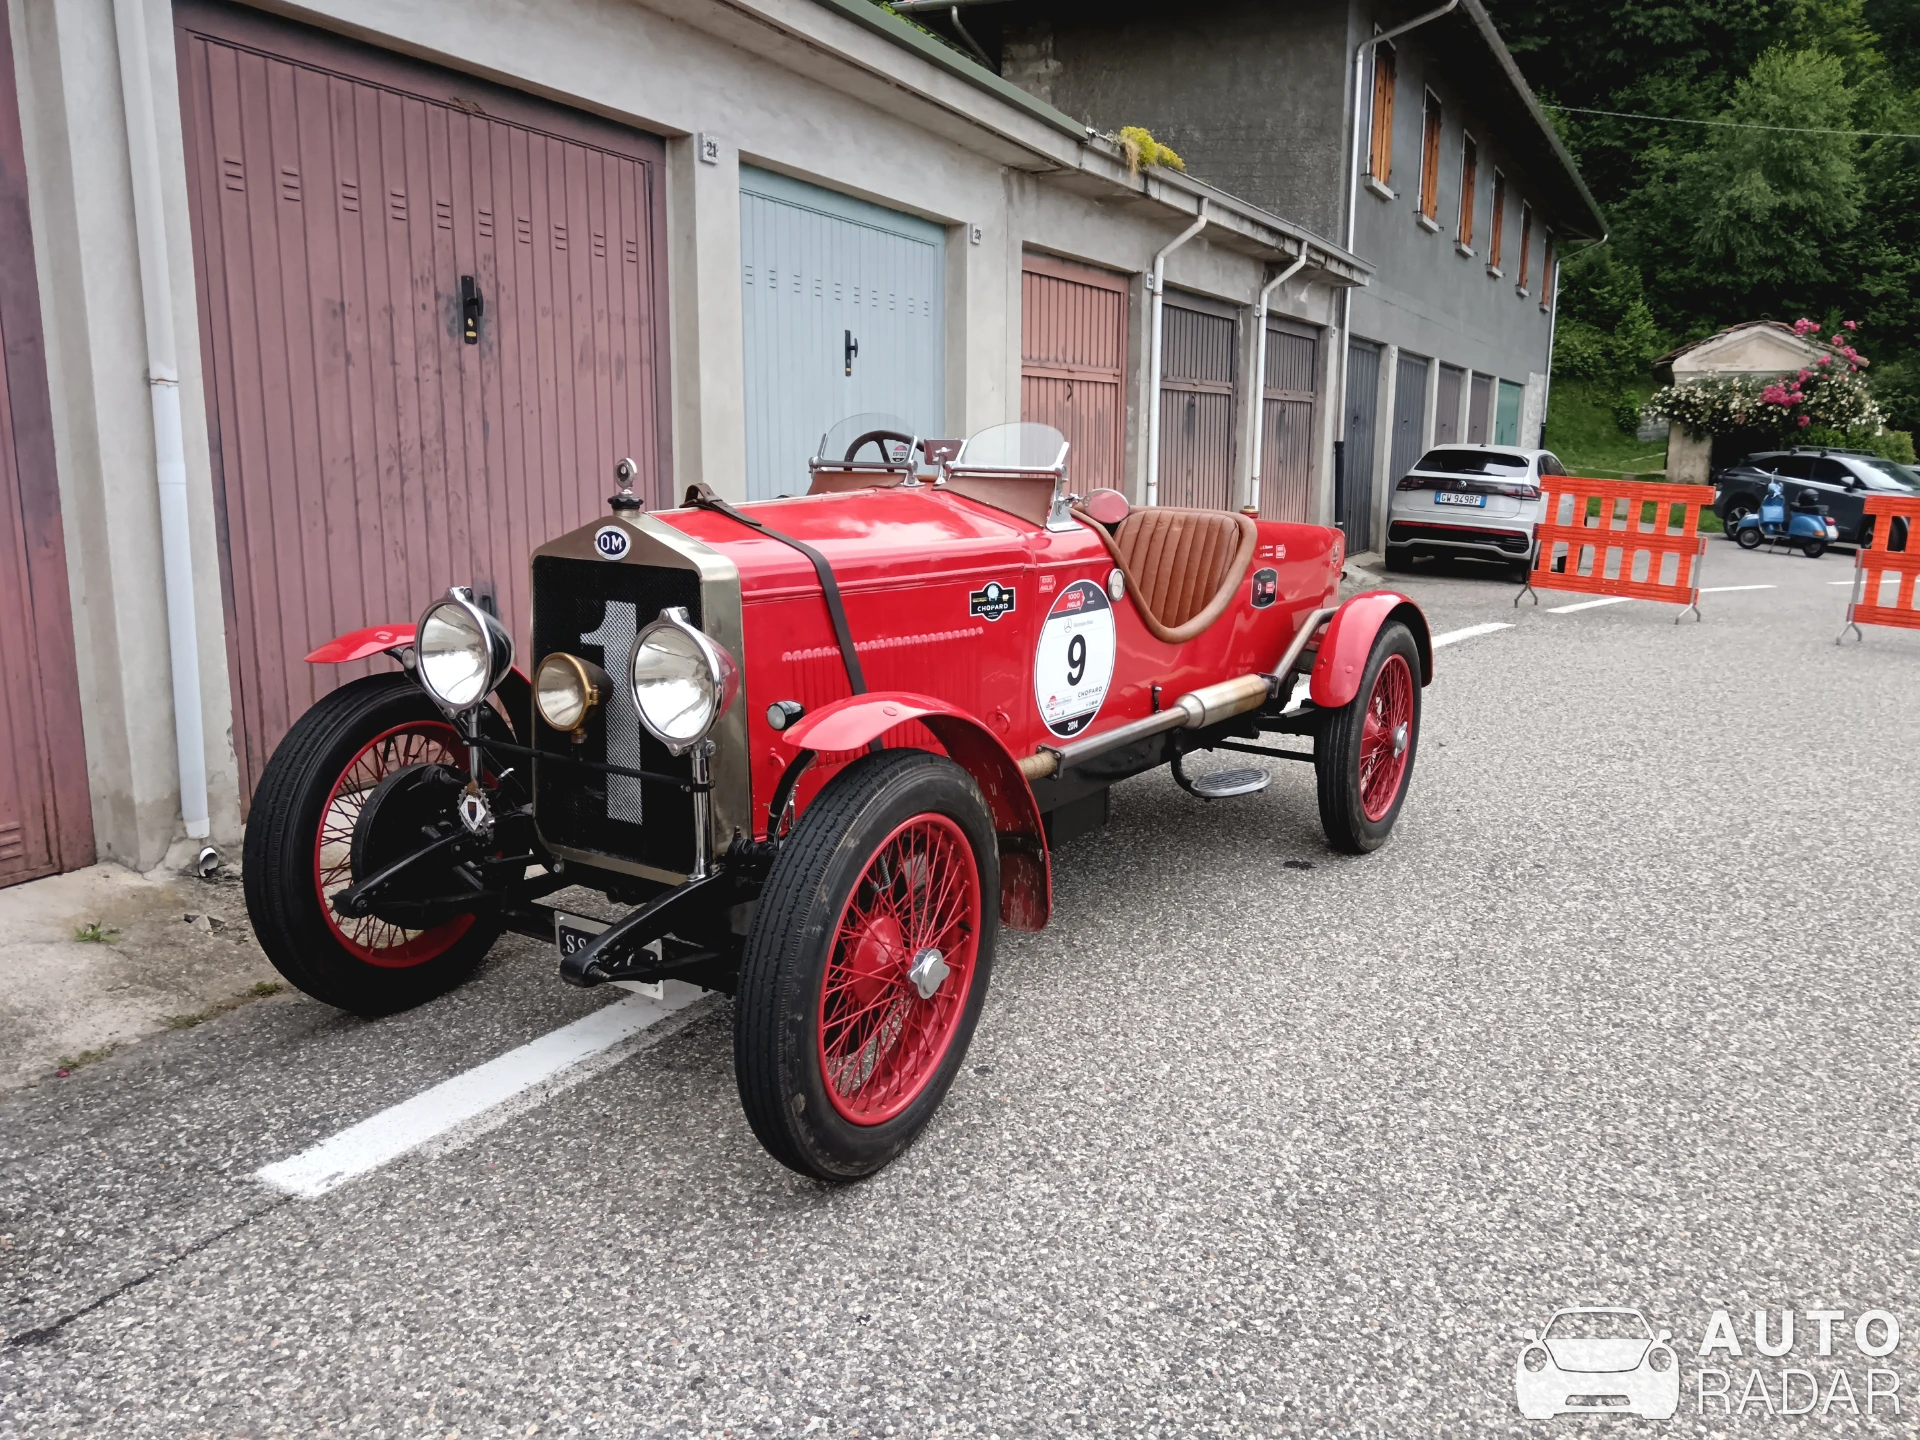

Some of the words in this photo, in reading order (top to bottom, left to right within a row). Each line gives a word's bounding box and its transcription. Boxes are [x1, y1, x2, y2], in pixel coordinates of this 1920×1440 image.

[706, 141, 717, 157] 21
[600, 534, 623, 551] OM
[977, 603, 1009, 612] CHOPARD
[1066, 633, 1087, 687] 9
[1077, 685, 1103, 698] CHOPARD
[1067, 719, 1079, 732] 2014
